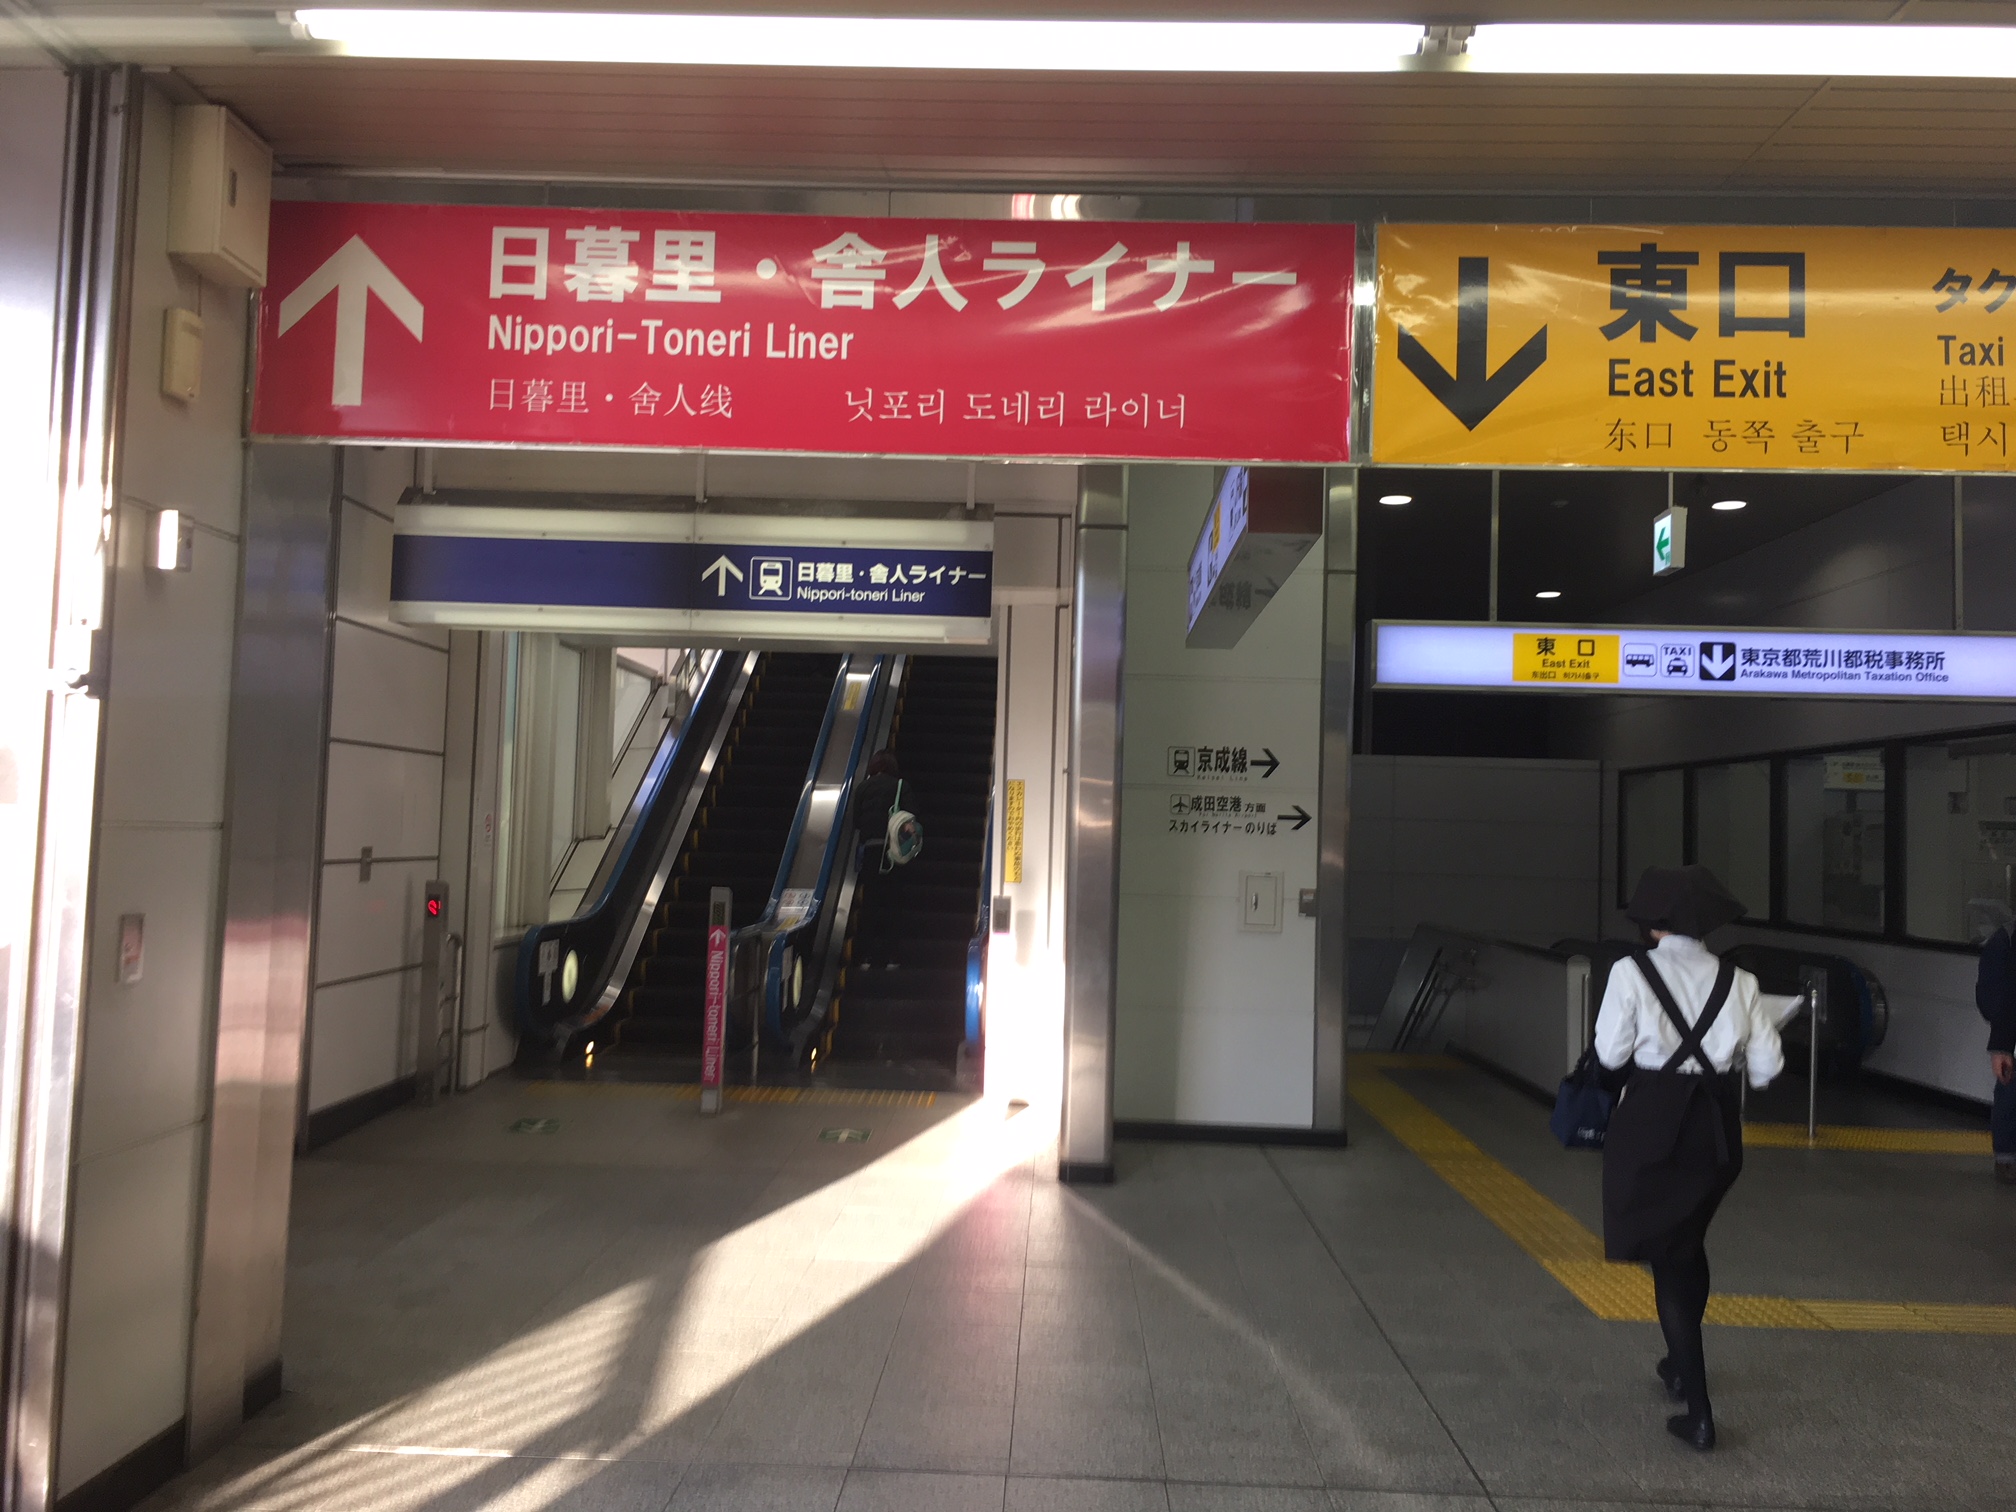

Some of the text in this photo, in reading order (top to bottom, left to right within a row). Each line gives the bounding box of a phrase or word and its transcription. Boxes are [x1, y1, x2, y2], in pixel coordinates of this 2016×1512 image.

[488, 224, 1297, 312] 日暮里・舎人ライナー
[1597, 242, 1806, 343] 東口
[488, 315, 854, 360] Nippori-Toneri Liner
[1937, 335, 2004, 367] Taxi
[1608, 358, 1787, 398] East Exit
[1940, 375, 2016, 408] 出租
[845, 387, 1185, 429] 닛포리 도네리 라이너
[1605, 418, 1673, 450] 东口
[1703, 419, 1865, 455] 동쪽 출구
[1941, 421, 2006, 457] 택시
[797, 561, 987, 585] 日暮里・舎人ライナー
[797, 586, 925, 603] Nippori-toneri Liner
[1542, 658, 1590, 669] East Exit
[1663, 646, 1692, 656] TAXI
[1740, 647, 1946, 671] 東京都荒川都税事務所
[1740, 669, 1949, 683] Arakawa Metropolitan Taxation Office
[1197, 745, 1248, 773] 京成線
